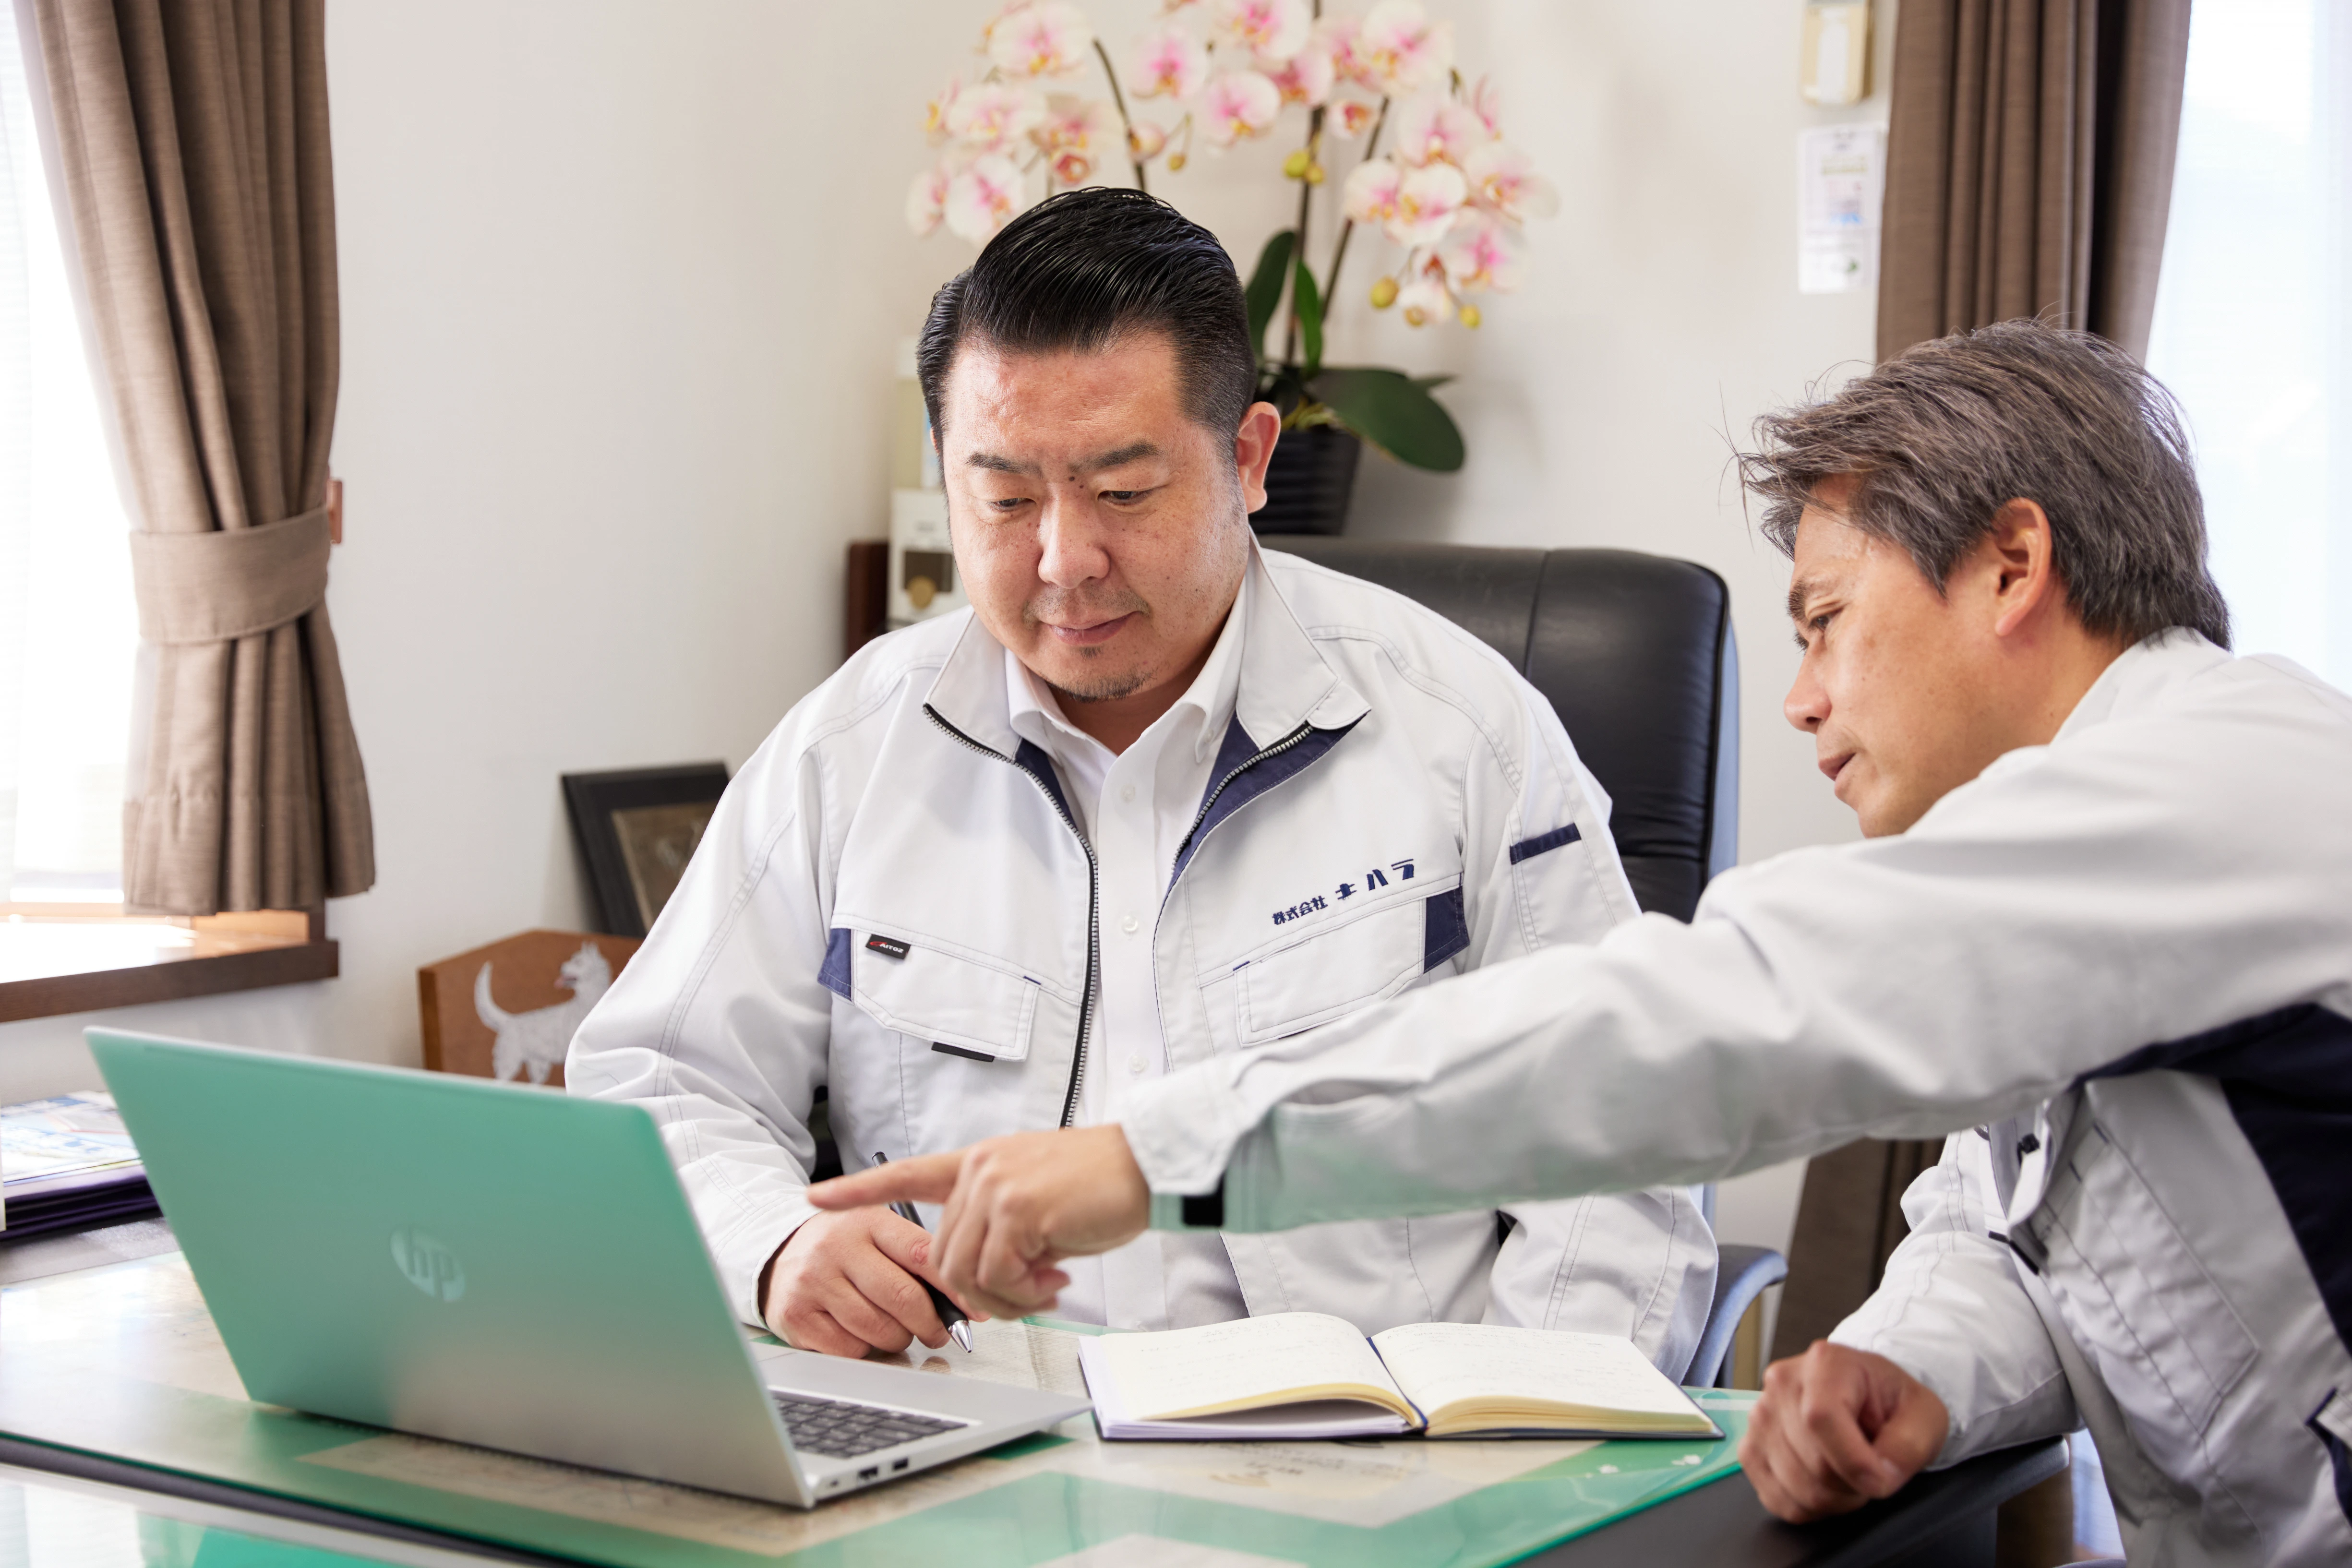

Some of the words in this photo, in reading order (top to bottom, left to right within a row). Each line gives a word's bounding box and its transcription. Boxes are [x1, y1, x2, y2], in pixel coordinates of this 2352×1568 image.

[1272, 896, 1328, 925] 株式会社
[879, 943, 904, 953] AITOZ
[403, 1226, 458, 1303] hp
